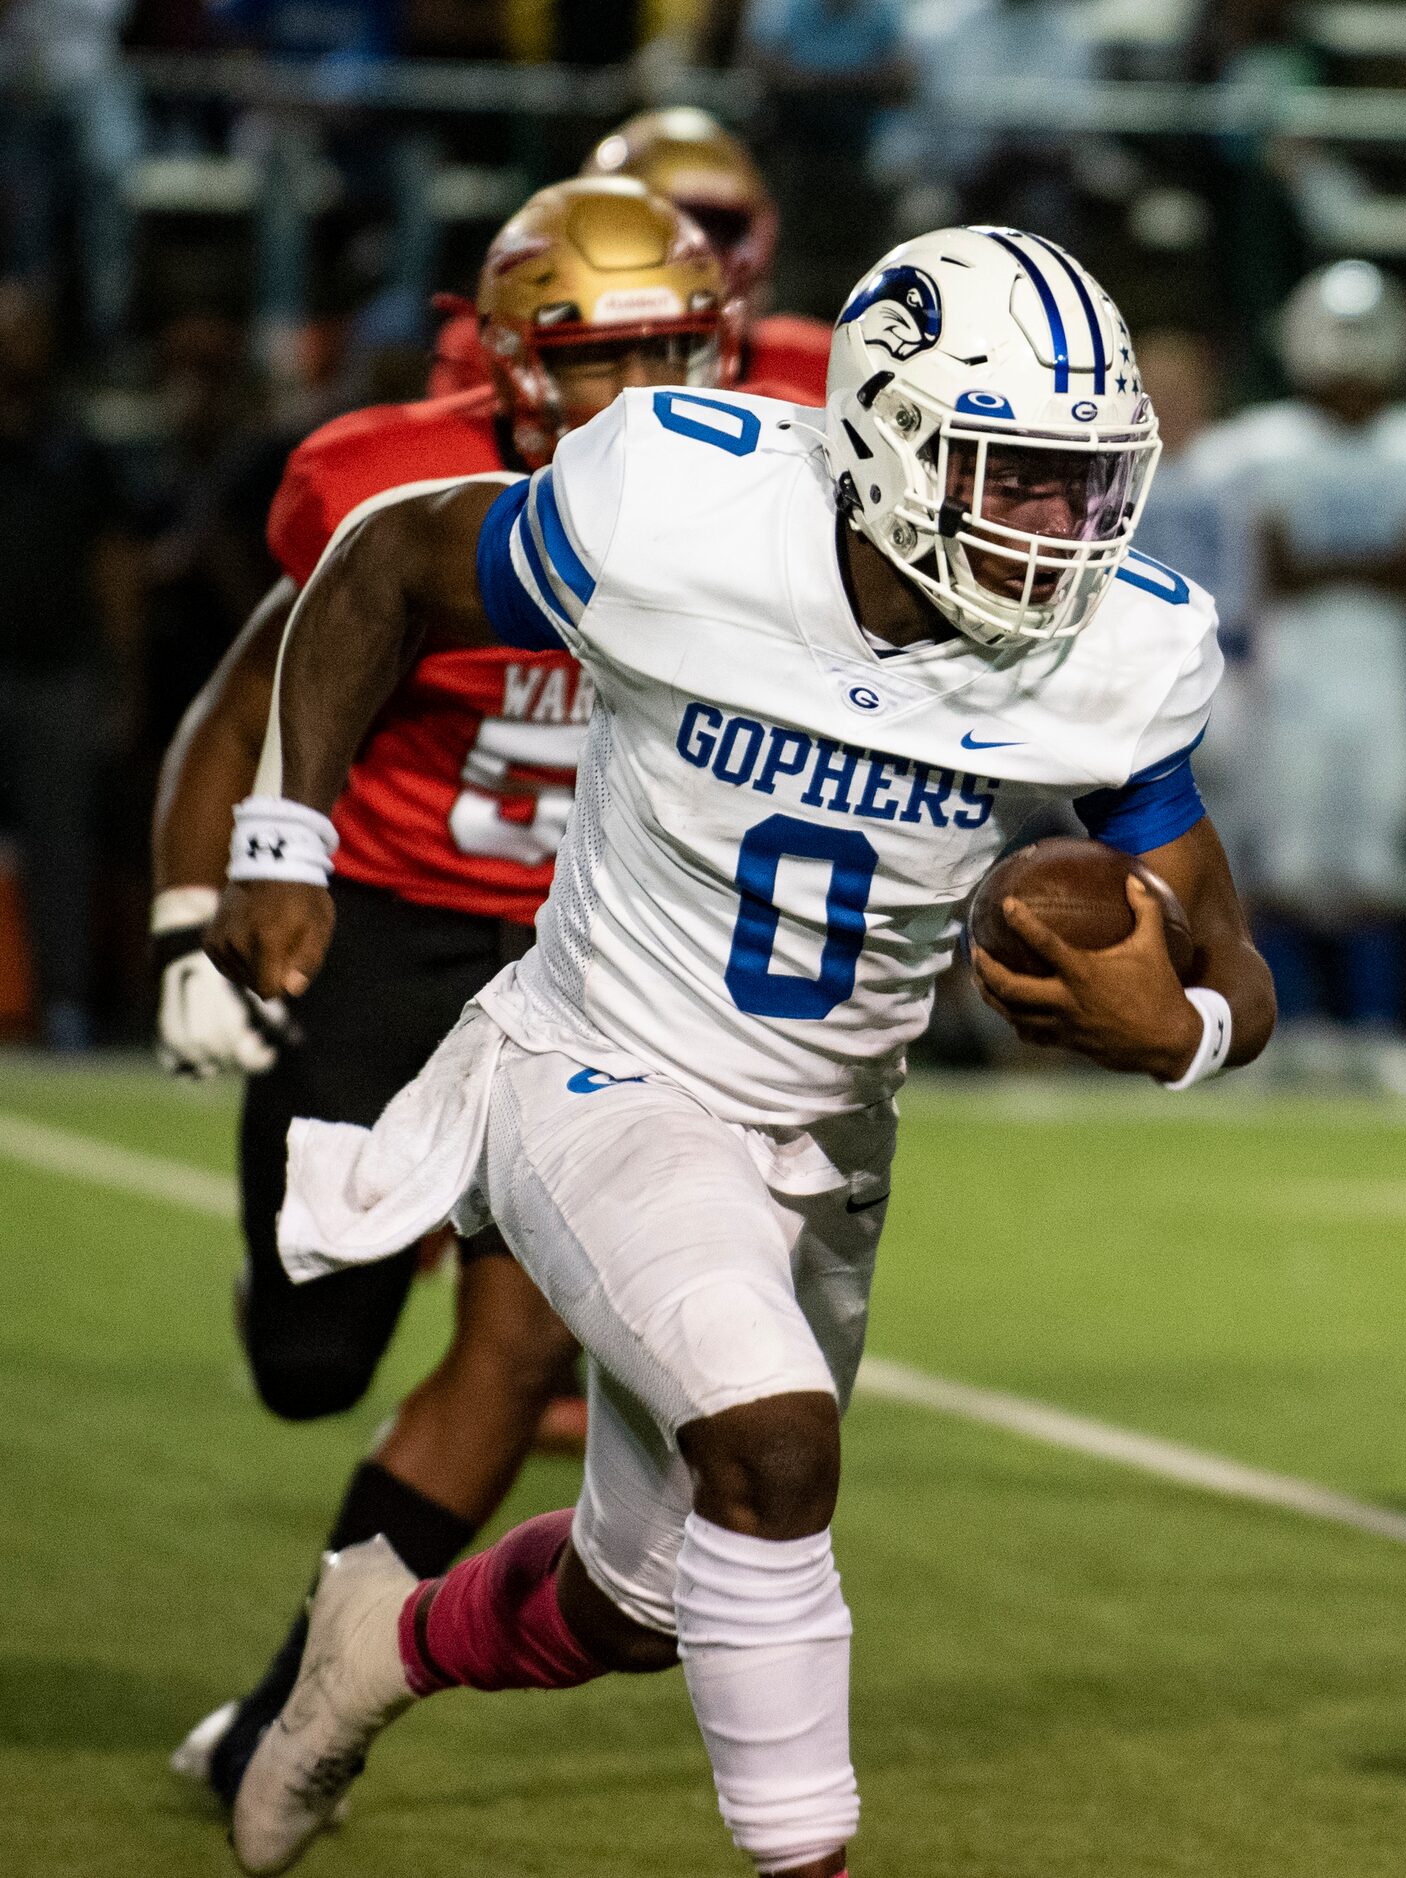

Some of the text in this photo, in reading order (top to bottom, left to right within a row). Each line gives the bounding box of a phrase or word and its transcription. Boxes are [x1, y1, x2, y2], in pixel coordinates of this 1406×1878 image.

[653, 391, 761, 457] 0
[1071, 401, 1098, 422] G
[849, 687, 879, 709] G
[676, 702, 1000, 829] GOPHERS
[724, 813, 879, 1020] 0
